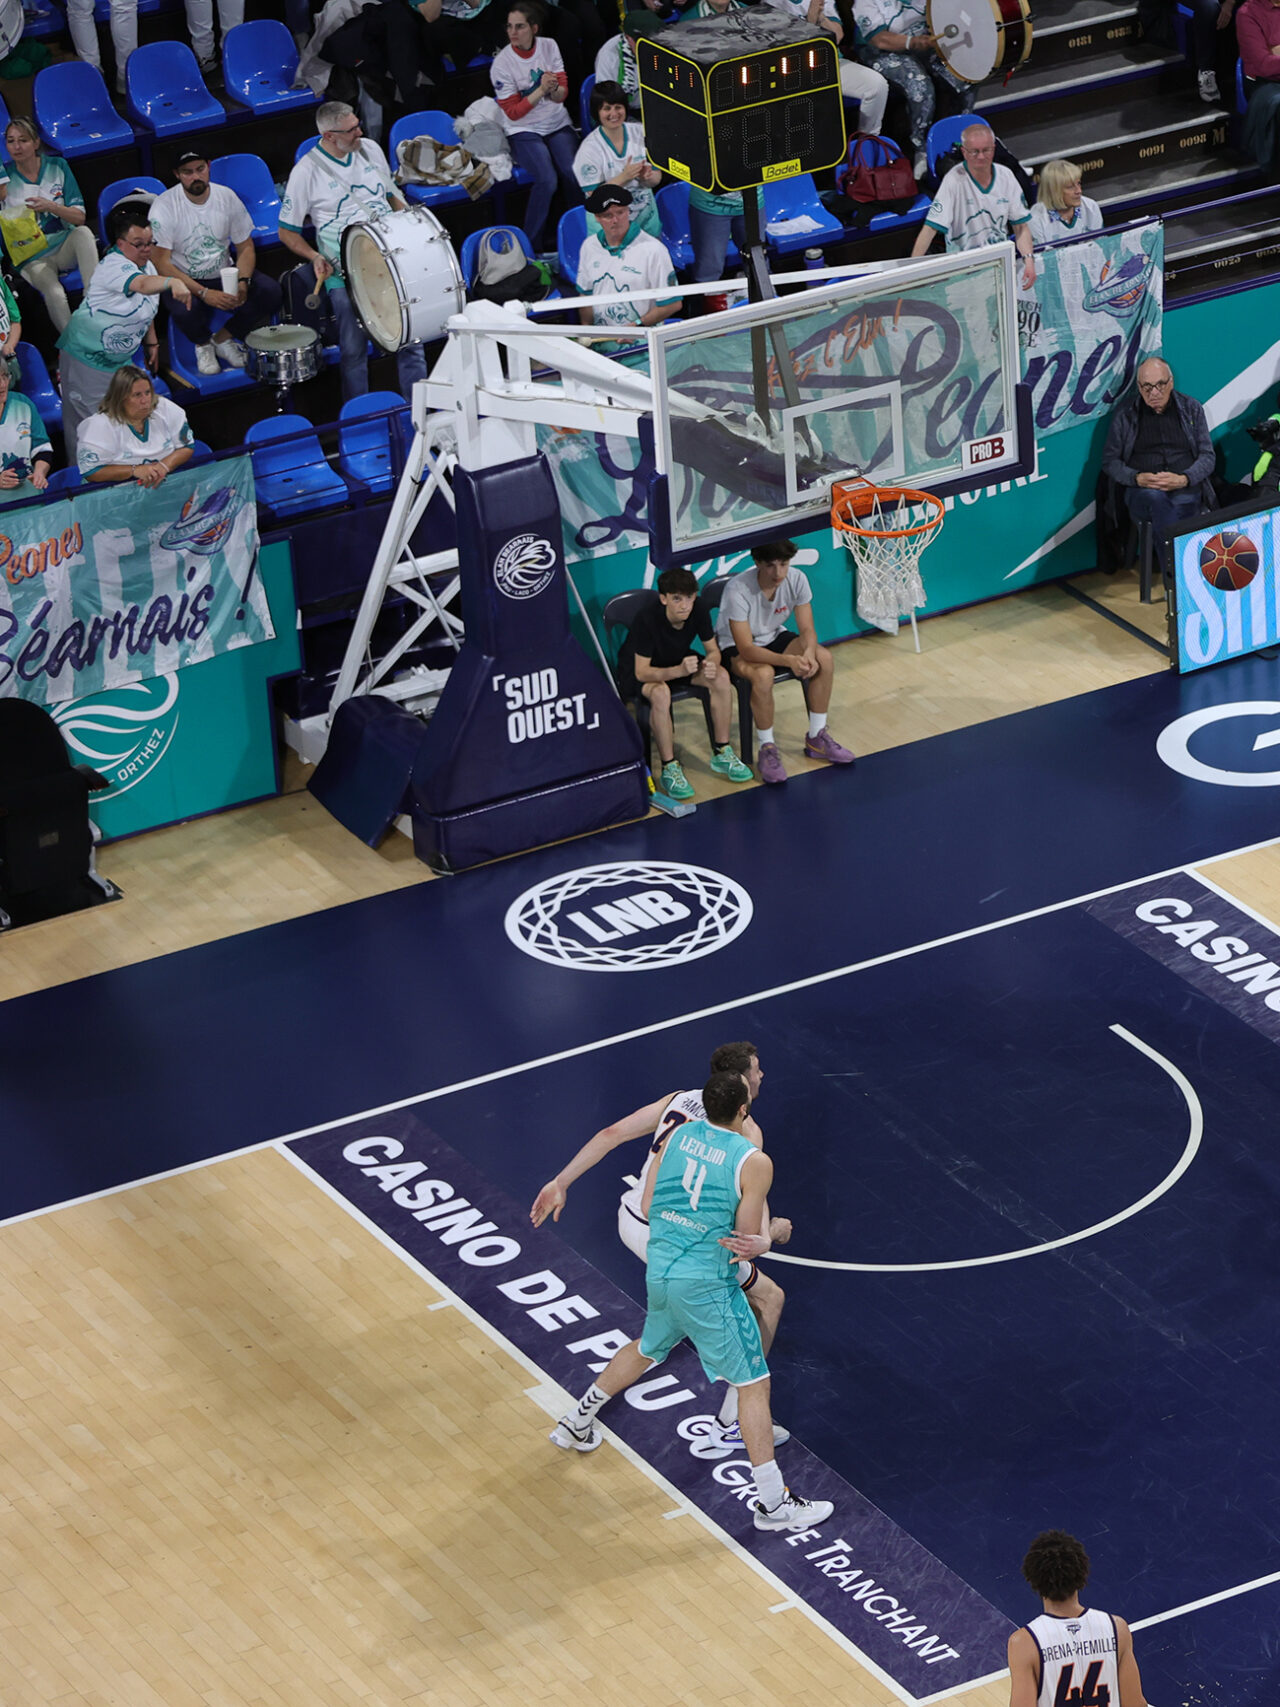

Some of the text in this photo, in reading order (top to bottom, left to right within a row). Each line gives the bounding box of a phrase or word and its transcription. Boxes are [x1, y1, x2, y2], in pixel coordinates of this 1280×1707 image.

[765, 162, 800, 179] Bodet
[505, 668, 558, 710] SUD
[507, 693, 587, 743] OUEST
[117, 728, 165, 781] ORTHEZ
[566, 890, 691, 943] LNB
[681, 1156, 707, 1212] 4
[343, 1135, 521, 1267] CASINO
[496, 1269, 601, 1332] DE
[565, 1329, 697, 1411] PU
[804, 1538, 960, 1665] TRANCHANT
